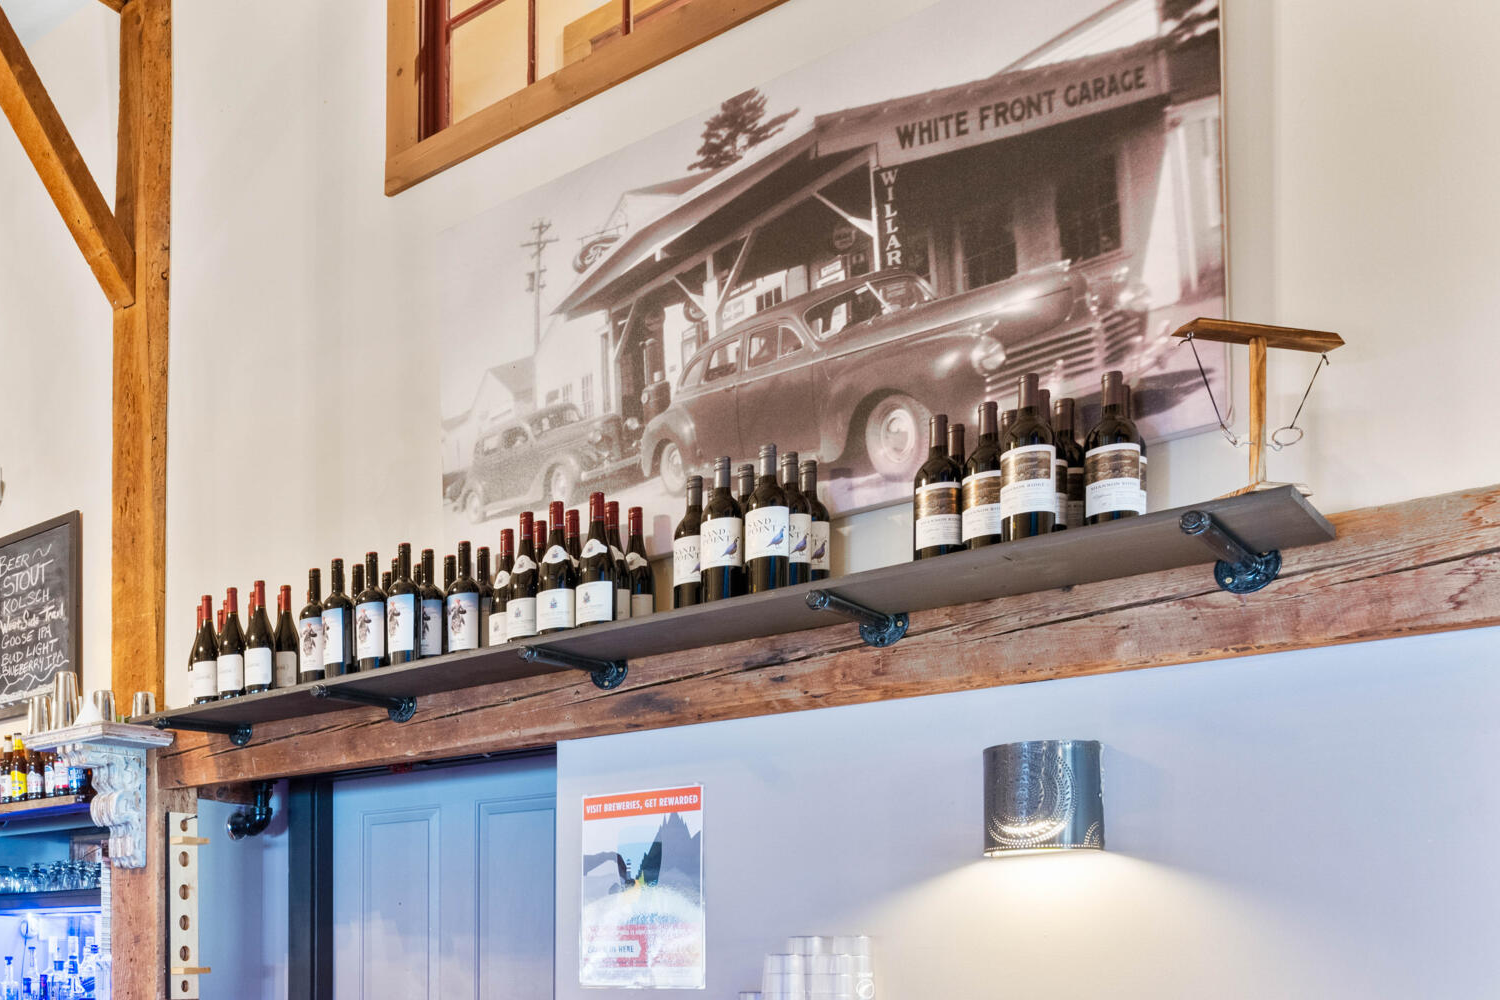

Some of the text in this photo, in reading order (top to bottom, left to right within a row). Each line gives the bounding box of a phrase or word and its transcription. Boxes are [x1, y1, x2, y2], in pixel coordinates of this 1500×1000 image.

[895, 66, 1148, 150] WHITE FRONT GARAGE
[879, 167, 902, 269] WILLAR
[3, 559, 54, 597] STOUT
[3, 586, 50, 616] KOLSCH
[1, 630, 35, 648] GOOSE
[38, 623, 53, 641] IPA
[1, 650, 24, 667] BUD
[26, 638, 59, 658] LIGHT
[2, 658, 44, 677] BLUEBERRY
[586, 794, 698, 814] VISIT BREWERIES, GET REWARDED
